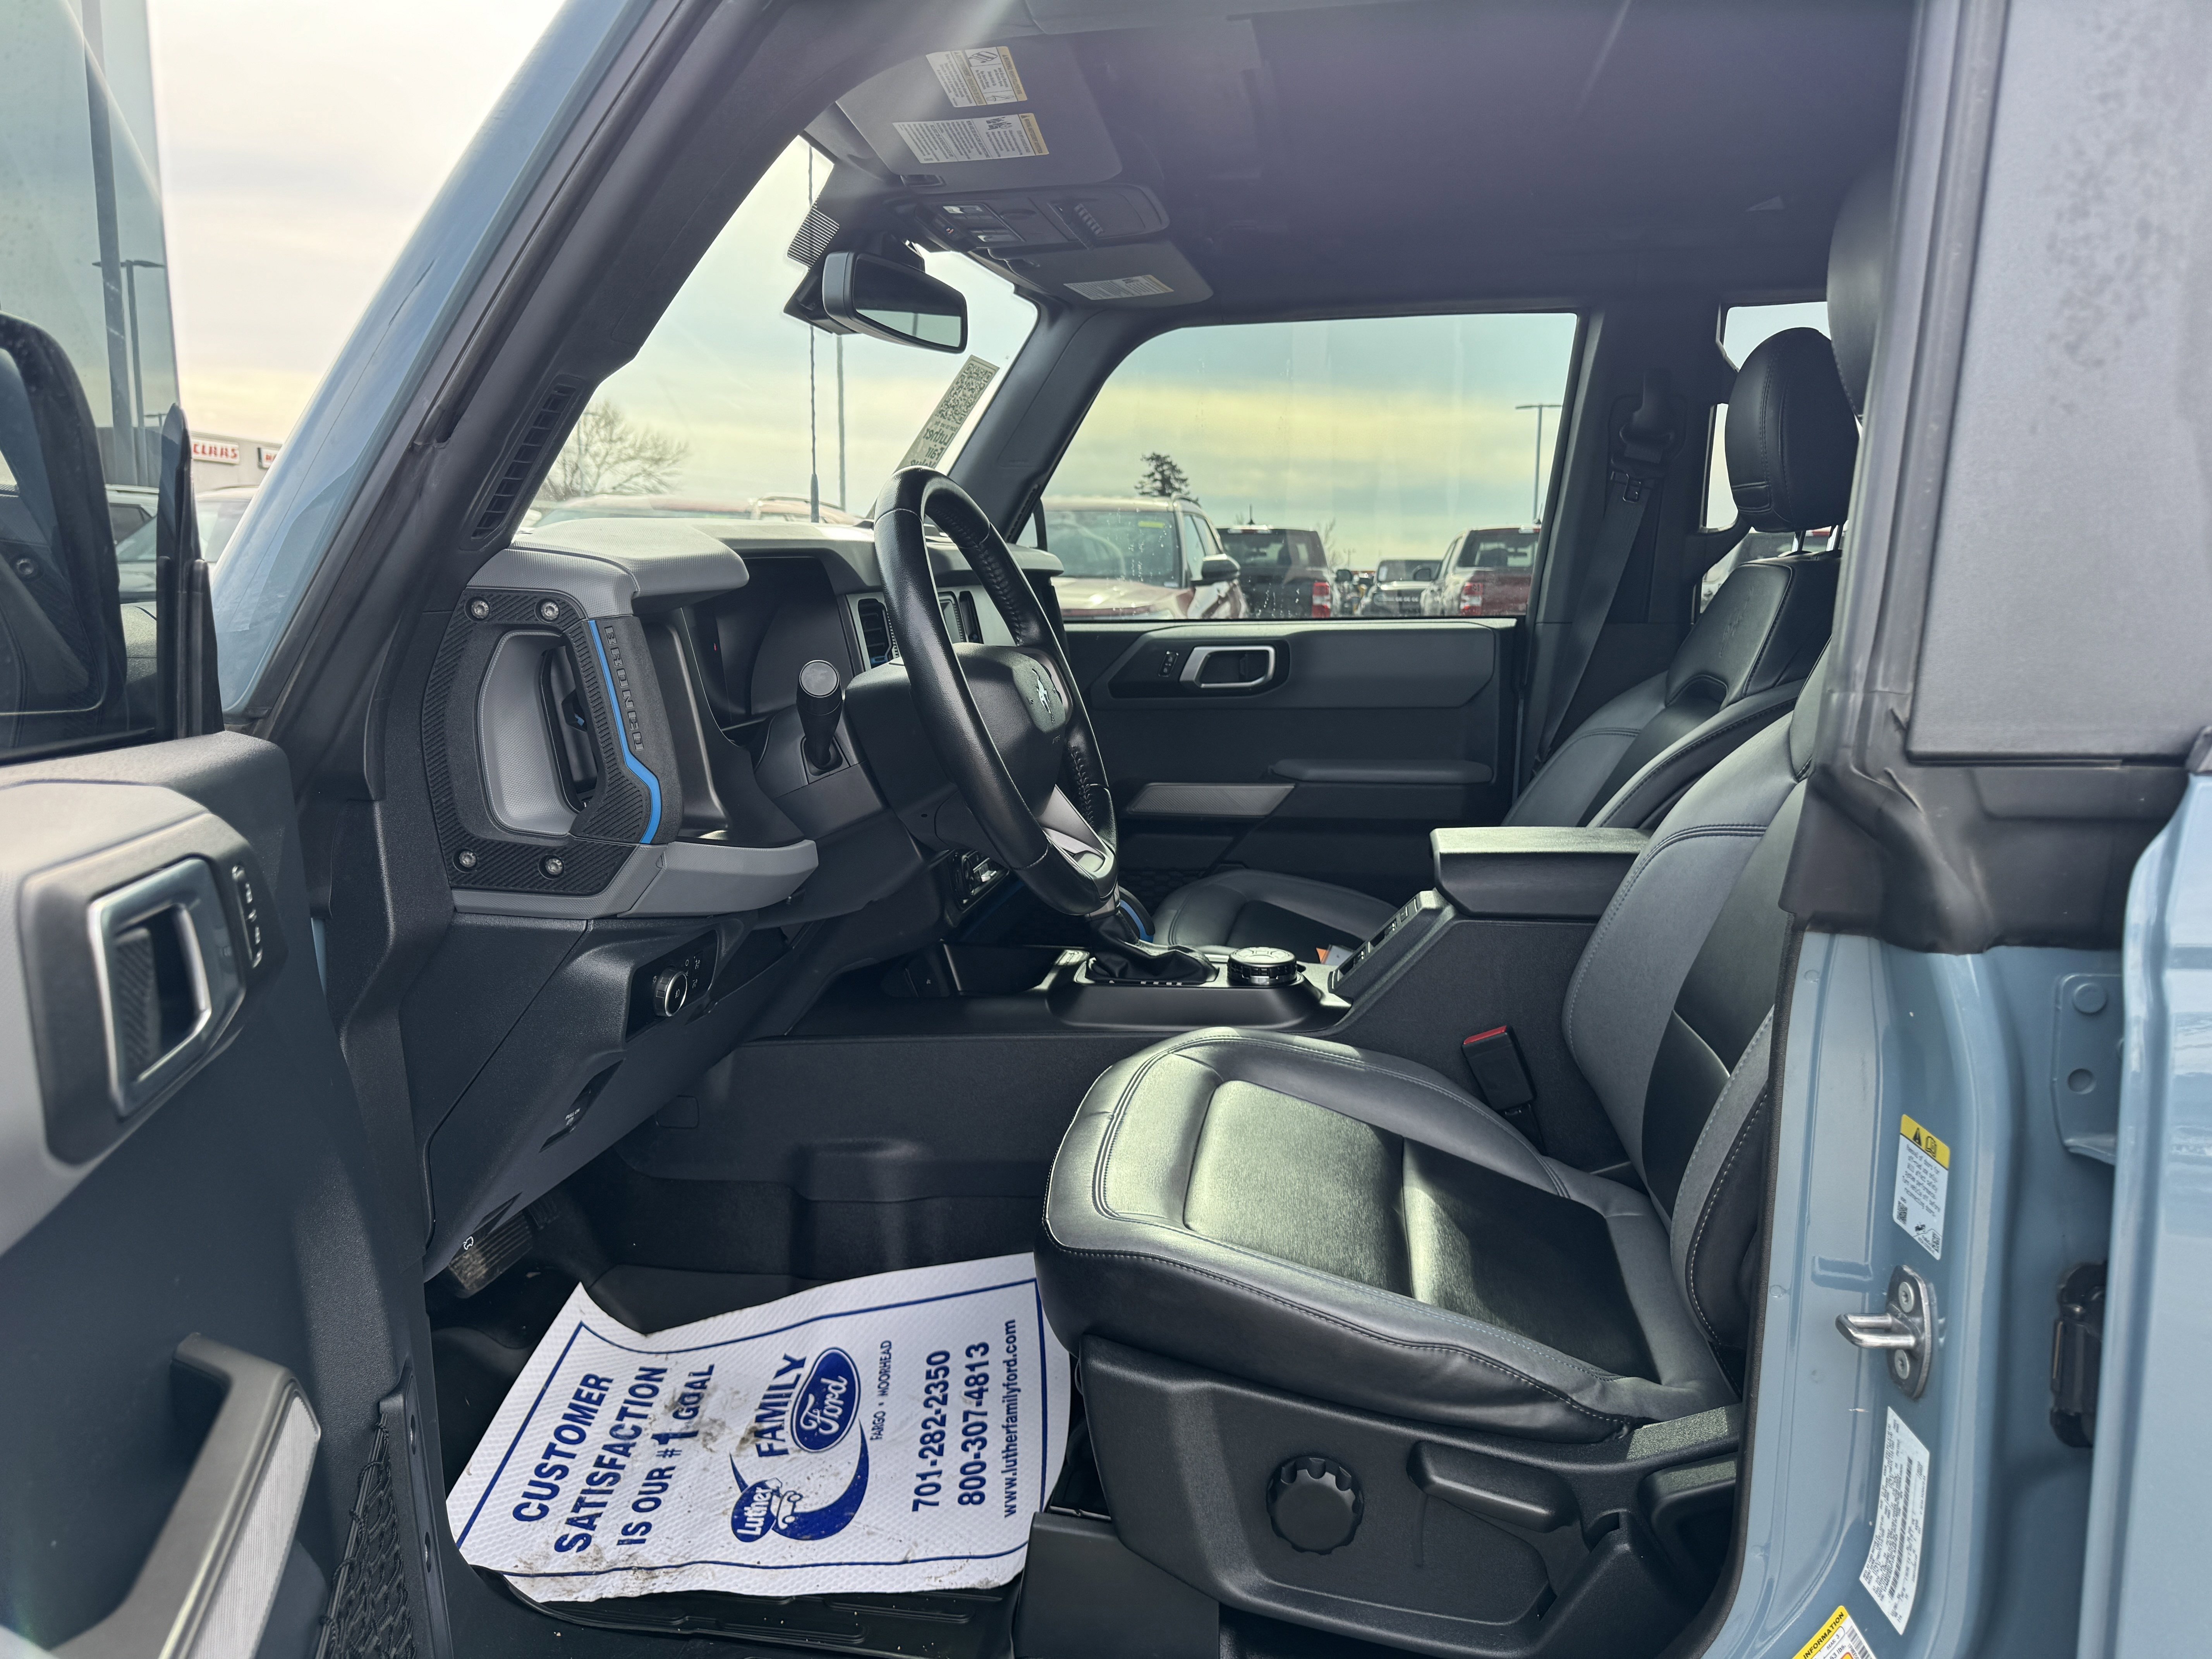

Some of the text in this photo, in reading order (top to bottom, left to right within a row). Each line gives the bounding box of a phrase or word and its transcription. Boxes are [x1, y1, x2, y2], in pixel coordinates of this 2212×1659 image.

[193, 443, 238, 459] CLAAS
[604, 626, 644, 750] BRONCO
[672, 1364, 715, 1420] GOAL
[754, 1353, 806, 1457] FAMILY
[800, 1376, 848, 1435] Ford
[870, 1340, 892, 1441] FARGO MOORHEAD
[912, 1350, 950, 1512] 701-282-2350
[958, 1341, 989, 1505] 800-307-4813
[1001, 1319, 1021, 1518] www.lutherfamilyford.com
[512, 1373, 614, 1521] CUSTOMER
[554, 1366, 668, 1553] SATISFACTION
[631, 1465, 676, 1513] OUR
[616, 1521, 652, 1546] IS
[737, 1487, 772, 1535] Luther
[1803, 1611, 1844, 1659] INFORMATION
